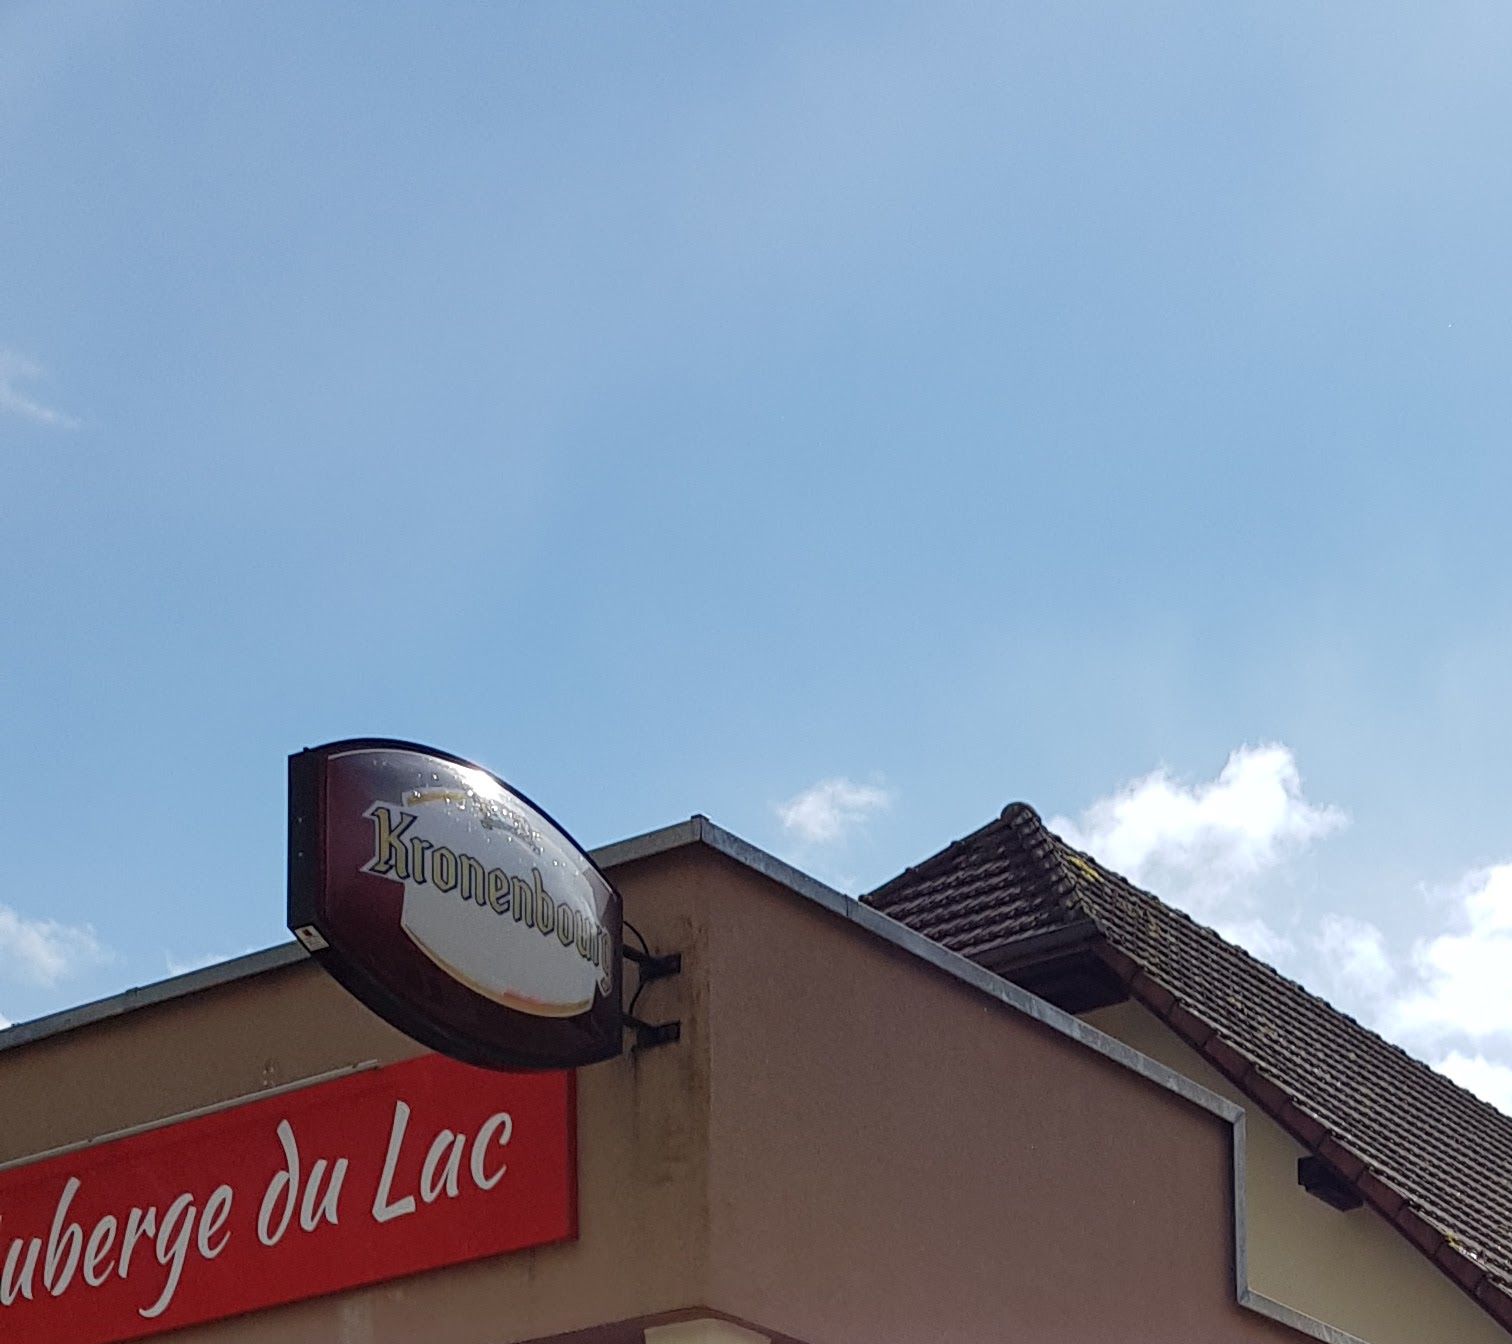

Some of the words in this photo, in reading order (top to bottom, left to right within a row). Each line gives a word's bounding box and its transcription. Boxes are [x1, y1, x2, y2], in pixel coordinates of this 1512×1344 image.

[0, 1176, 234, 1319] uberge
[256, 1119, 349, 1247] du
[371, 1100, 513, 1224] Lac
